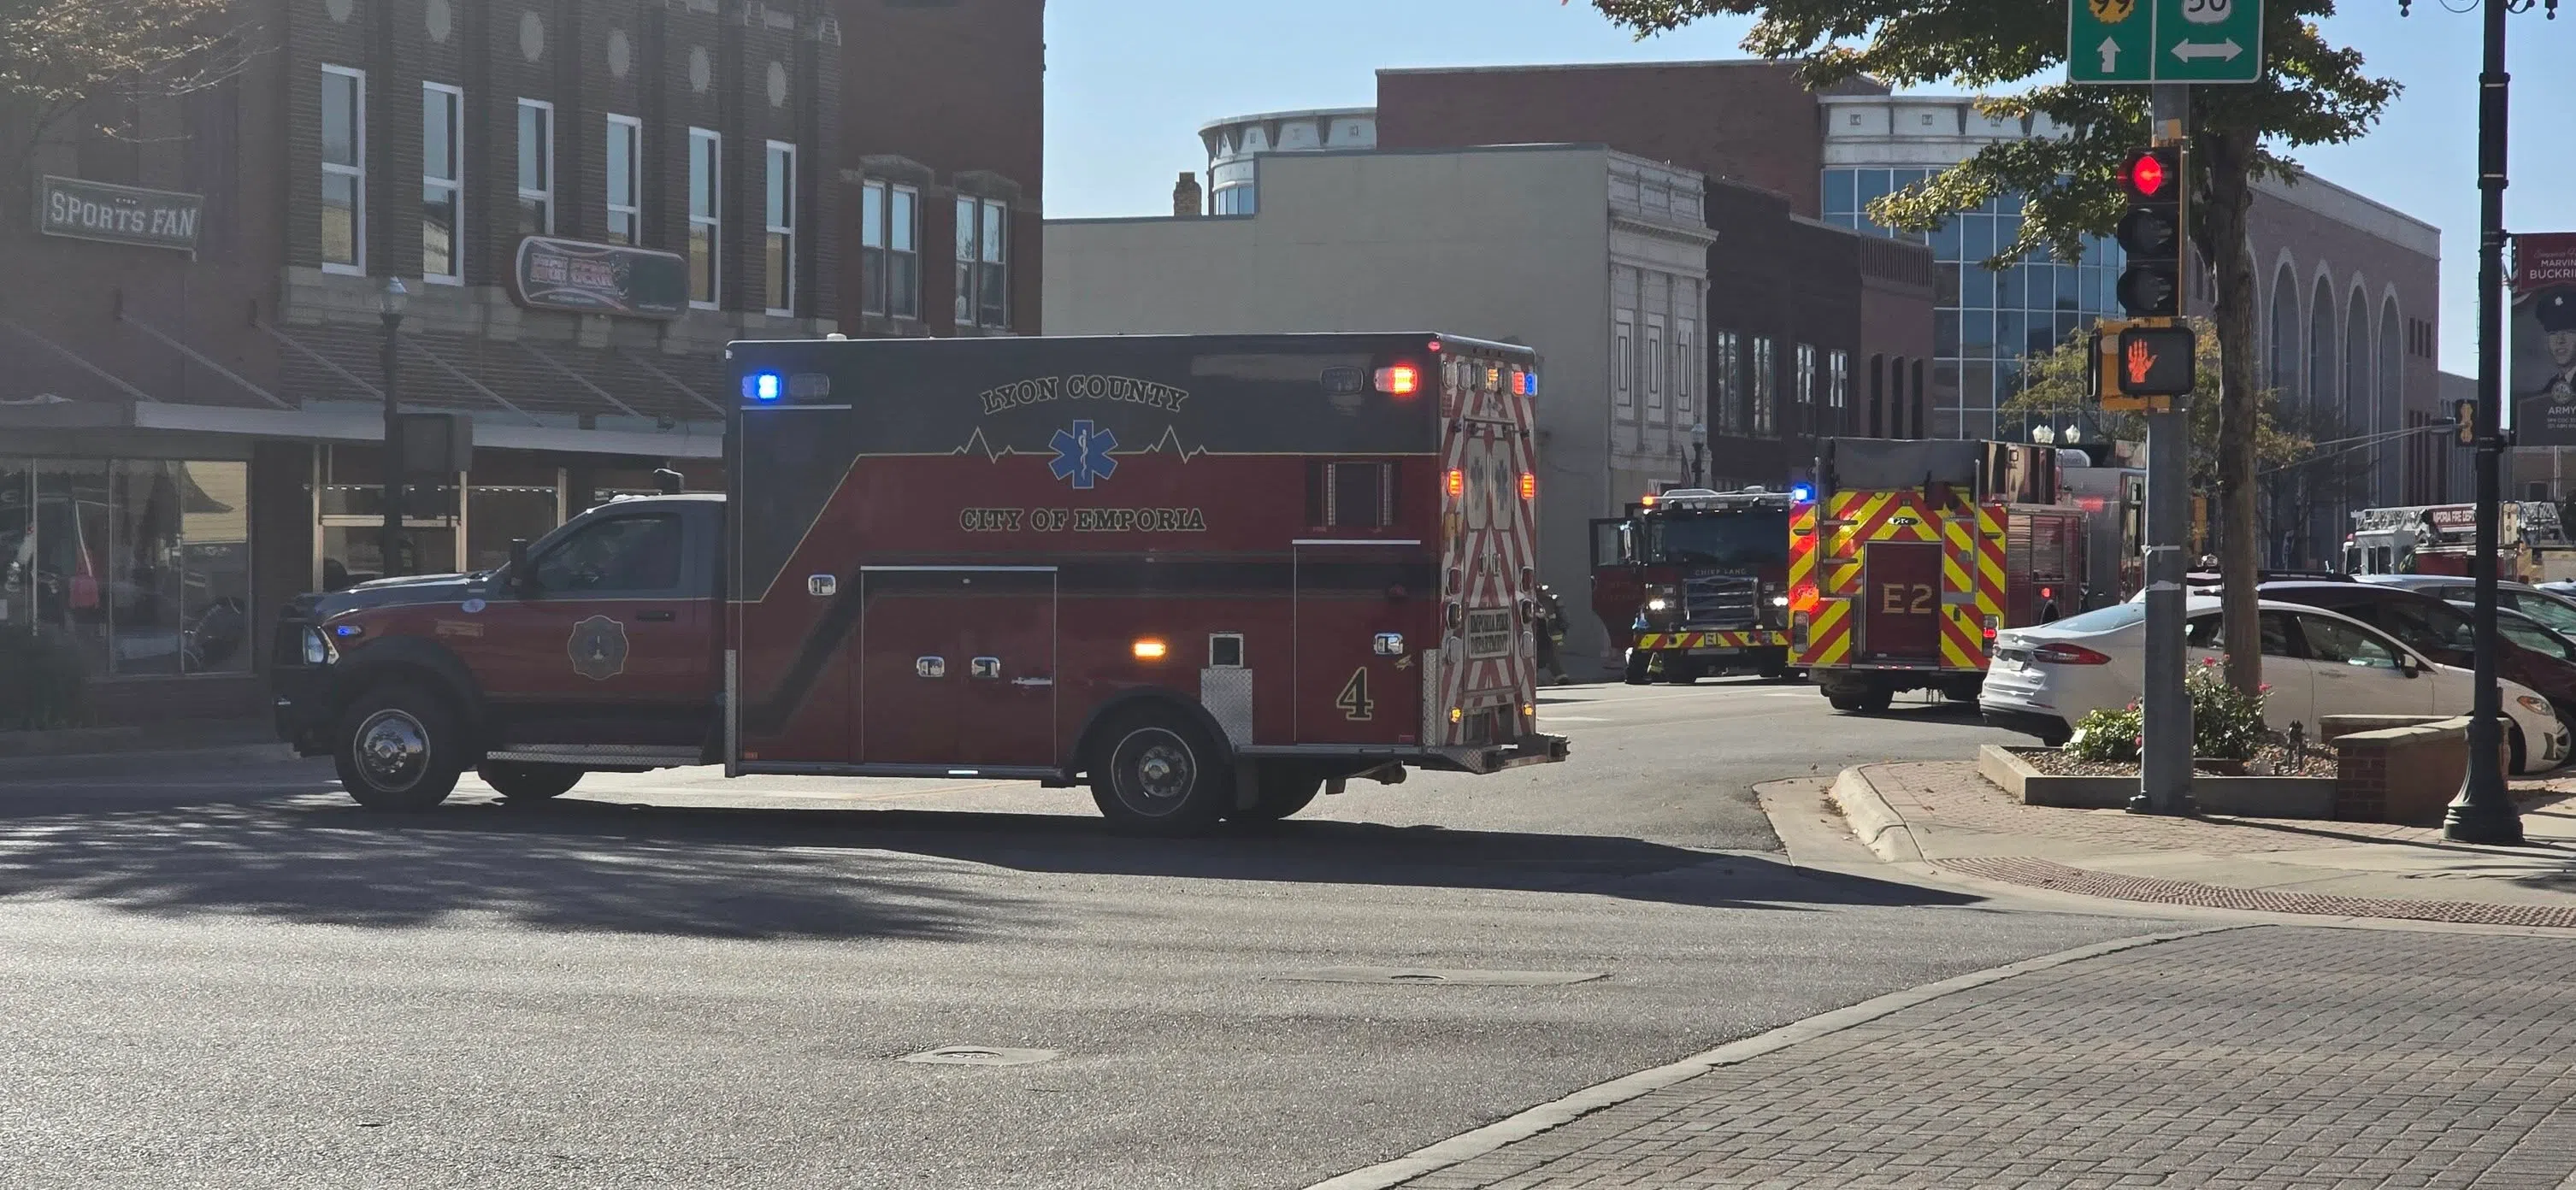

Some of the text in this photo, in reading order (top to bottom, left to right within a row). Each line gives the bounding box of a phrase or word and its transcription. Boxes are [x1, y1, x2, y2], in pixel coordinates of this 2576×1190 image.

[51, 191, 197, 237] SPORTS FAN
[2530, 268, 2576, 280] BUCKRI
[980, 374, 1189, 415] LYON COUNTY
[2548, 405, 2576, 415] ARMY
[959, 508, 1206, 531] CITY OF EMPORIA
[2432, 511, 2451, 523] MPORIA
[1882, 583, 1932, 614] E2
[1335, 666, 1375, 721] 4
